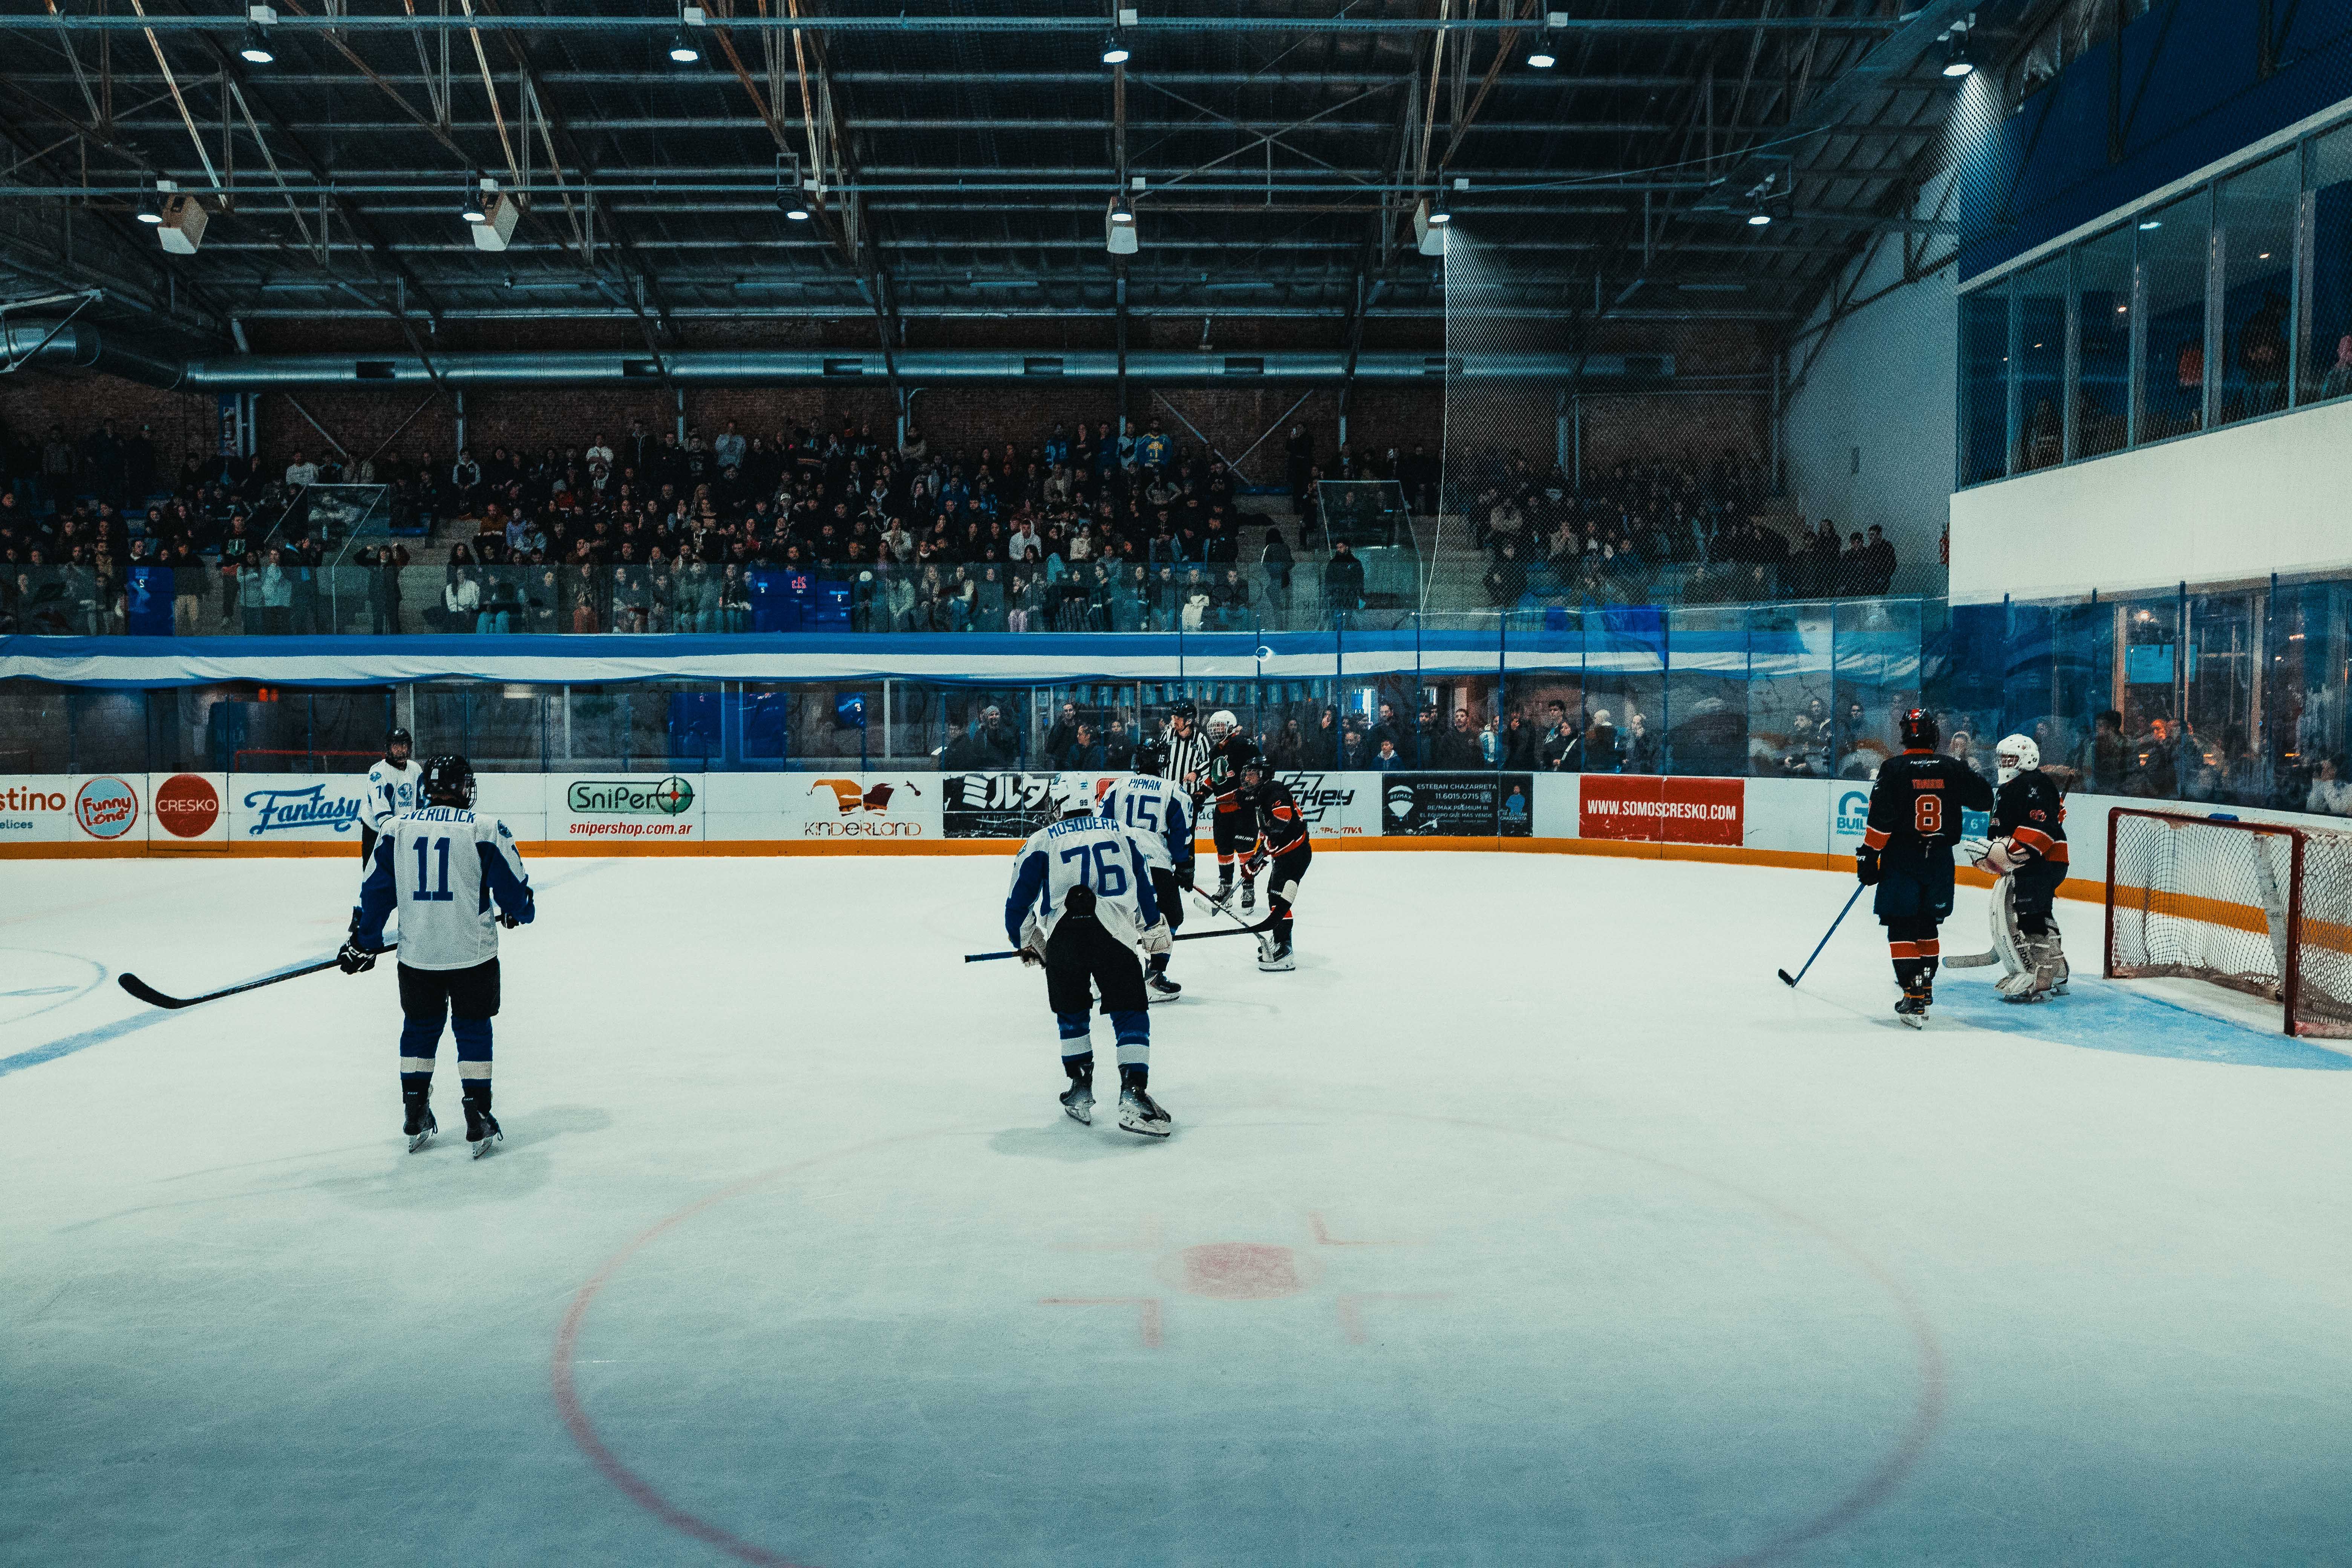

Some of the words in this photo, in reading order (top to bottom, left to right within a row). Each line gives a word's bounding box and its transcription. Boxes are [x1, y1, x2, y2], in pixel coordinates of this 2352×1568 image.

[1129, 778, 1161, 790] PIPMAN
[82, 796, 131, 813] Funny
[158, 799, 216, 812] CRESKO
[244, 784, 363, 835] Fantasy
[1125, 794, 1161, 833] 15
[1588, 800, 1736, 820] WWW.SOMOSCRESKO.COM
[1915, 794, 1942, 831] 8
[570, 821, 693, 837] snipershop.com.ar
[1047, 816, 1119, 839] MOSQUERA
[413, 836, 453, 901] 11
[1060, 840, 1128, 897] 76
